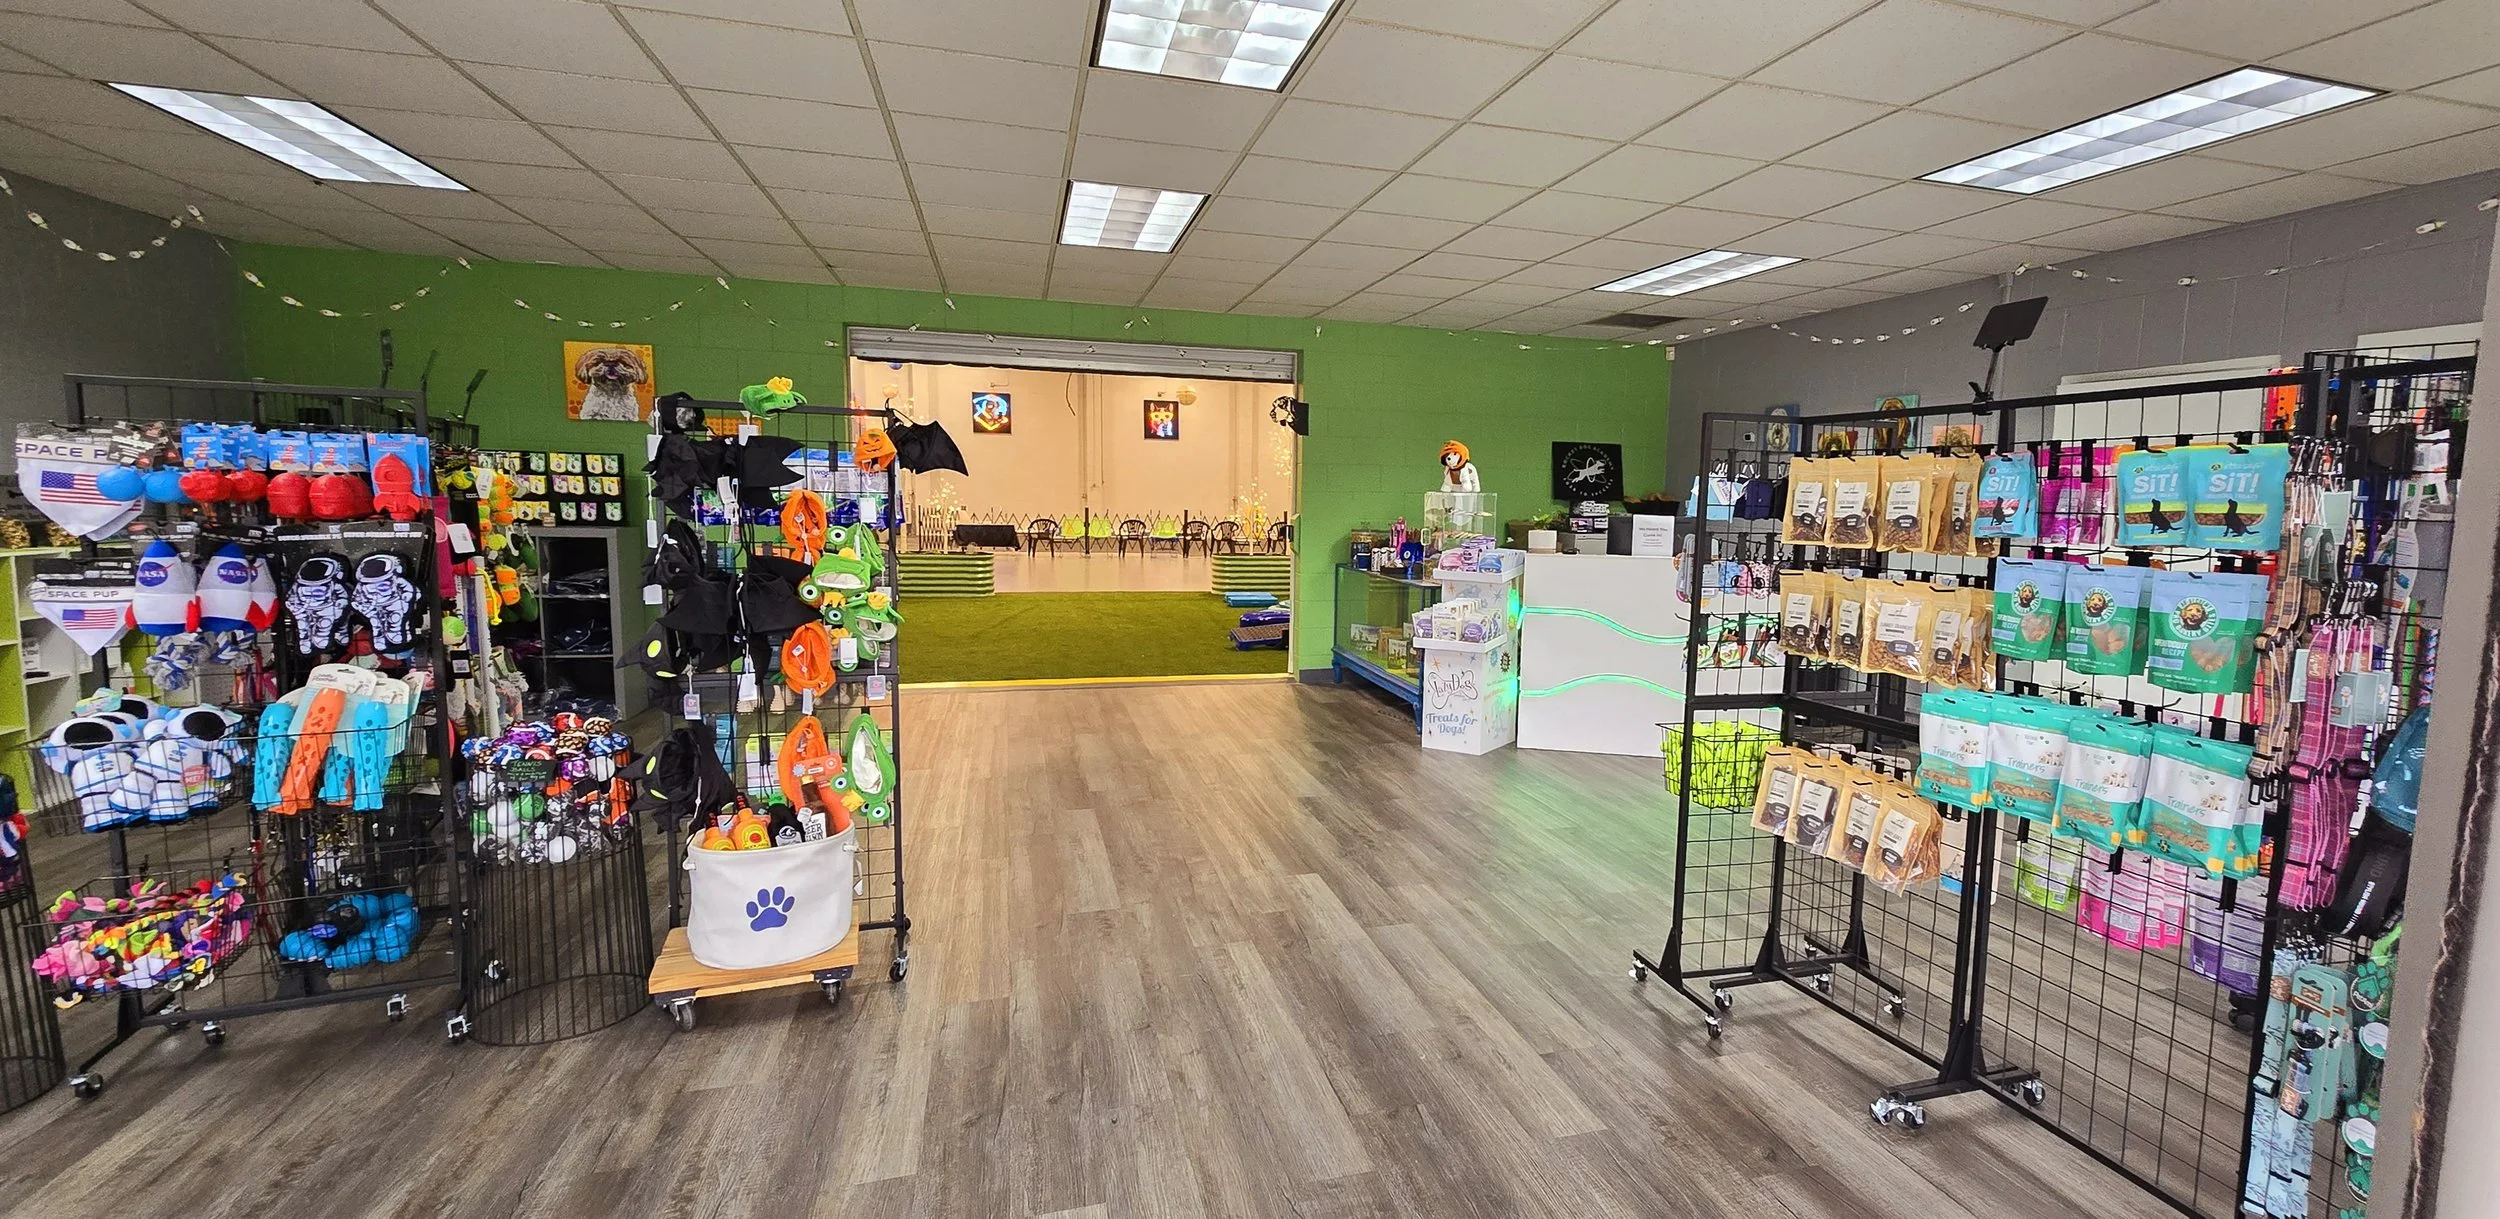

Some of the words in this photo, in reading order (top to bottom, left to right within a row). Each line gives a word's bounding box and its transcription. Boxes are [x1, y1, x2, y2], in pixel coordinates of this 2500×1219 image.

[15, 442, 83, 458] SPACE
[2208, 472, 2260, 493] SiT!
[219, 568, 247, 577] NASA
[47, 590, 91, 599] SPACE
[93, 590, 120, 599] PUP
[1425, 712, 1459, 724] Treats
[1460, 713, 1478, 726] for
[1437, 722, 1467, 736] Dogs!
[1932, 745, 1965, 761] Trainers
[2007, 757, 2046, 774] Trainers
[2074, 778, 2108, 795] Trainers
[2167, 795, 2206, 817] Trainers
